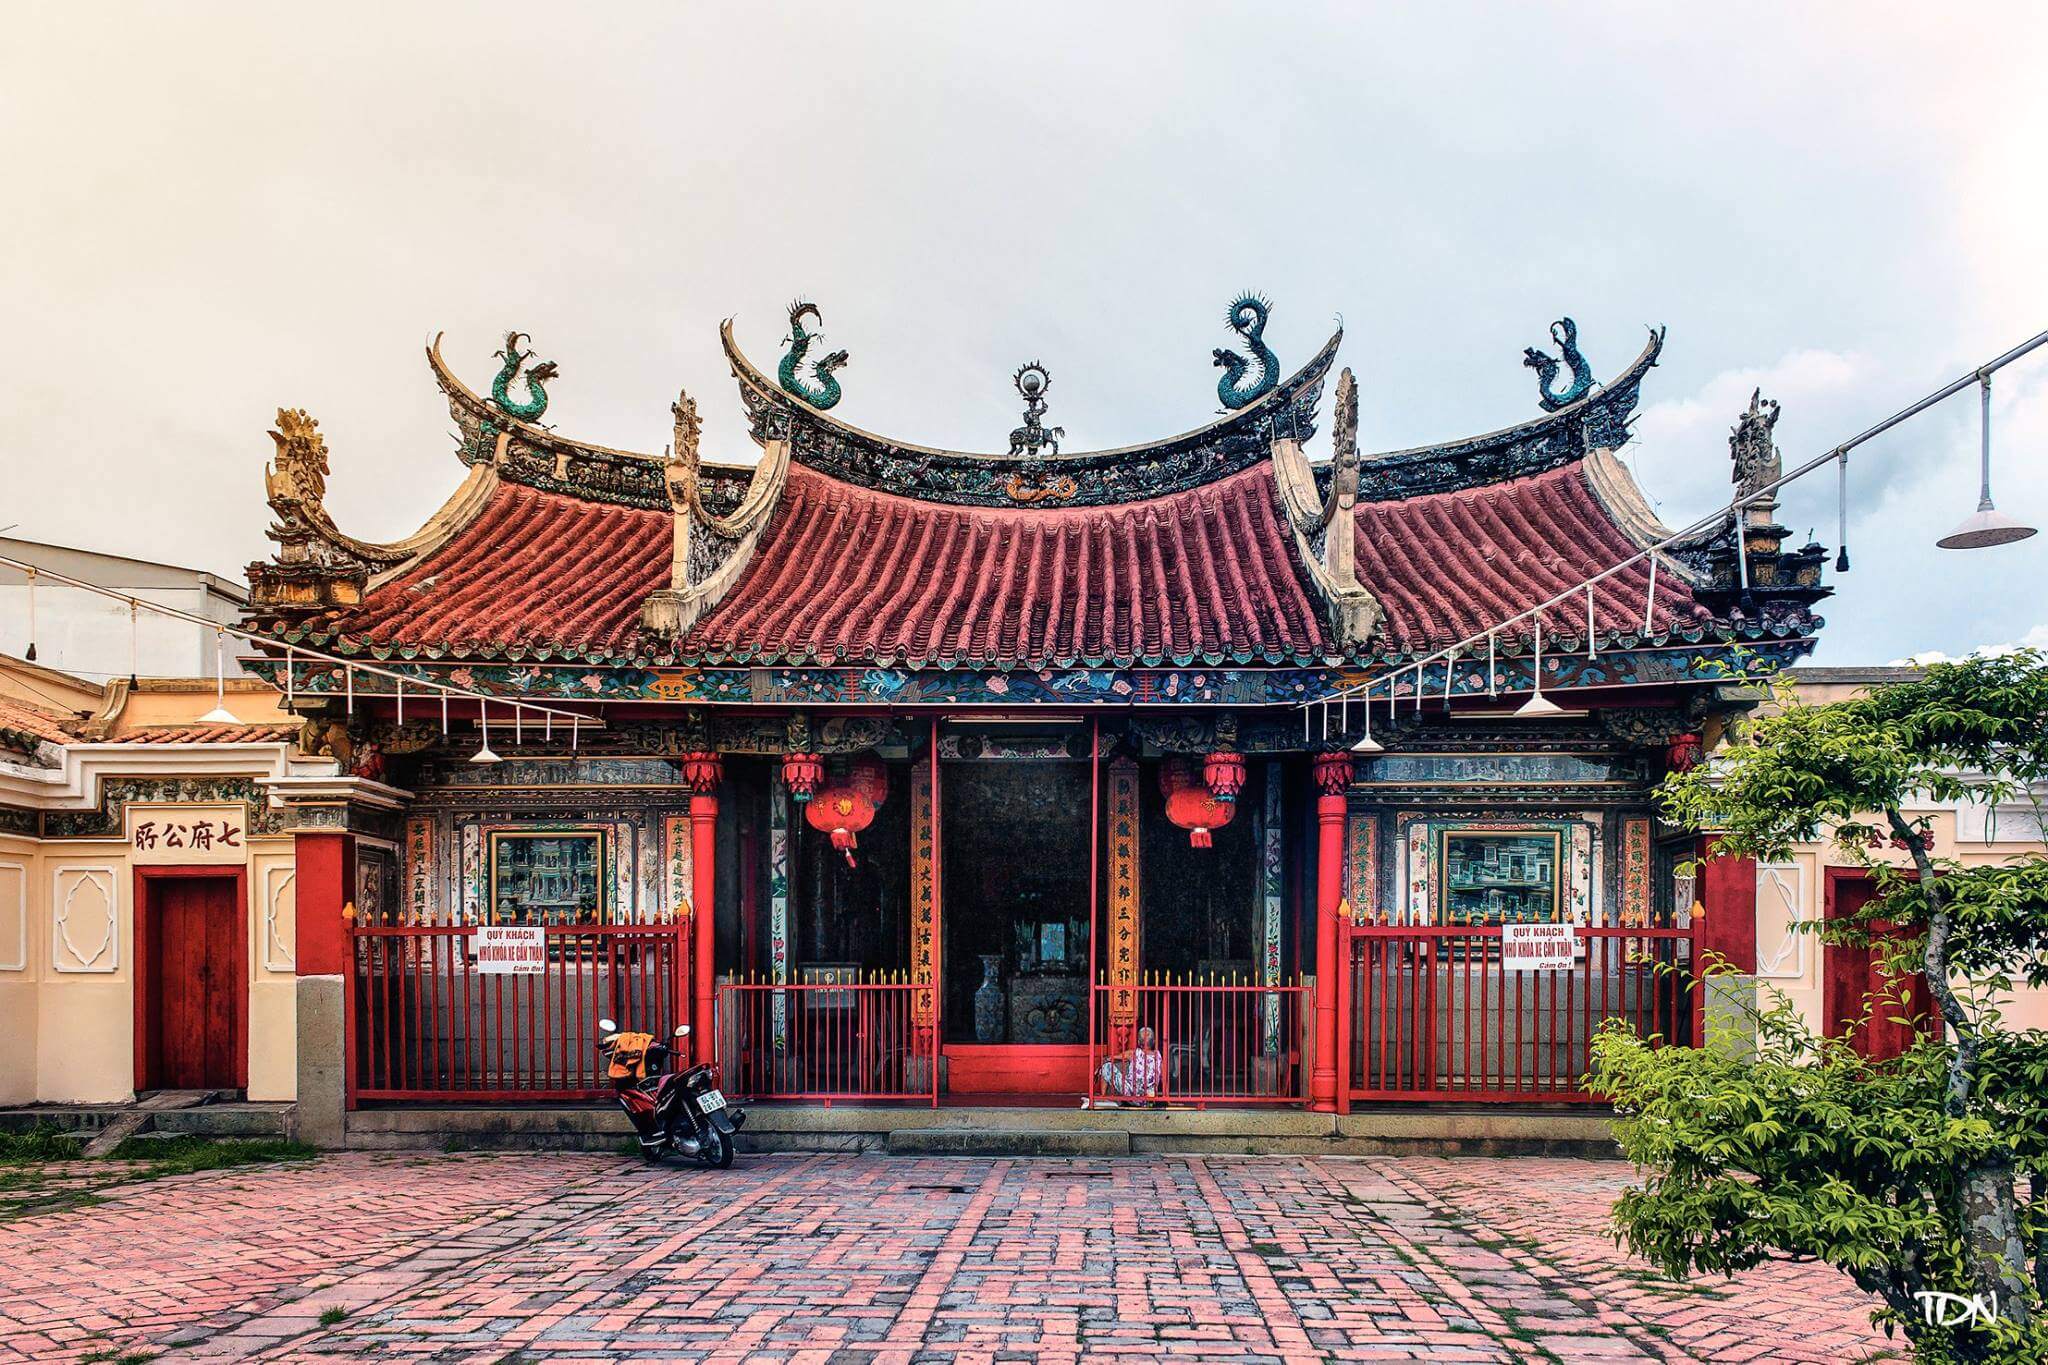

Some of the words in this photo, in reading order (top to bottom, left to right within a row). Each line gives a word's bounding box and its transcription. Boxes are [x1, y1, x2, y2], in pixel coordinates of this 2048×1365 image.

[487, 928, 503, 940] QUÝ
[506, 928, 535, 940] KHÁCH
[1533, 925, 1564, 937] KHÁCH
